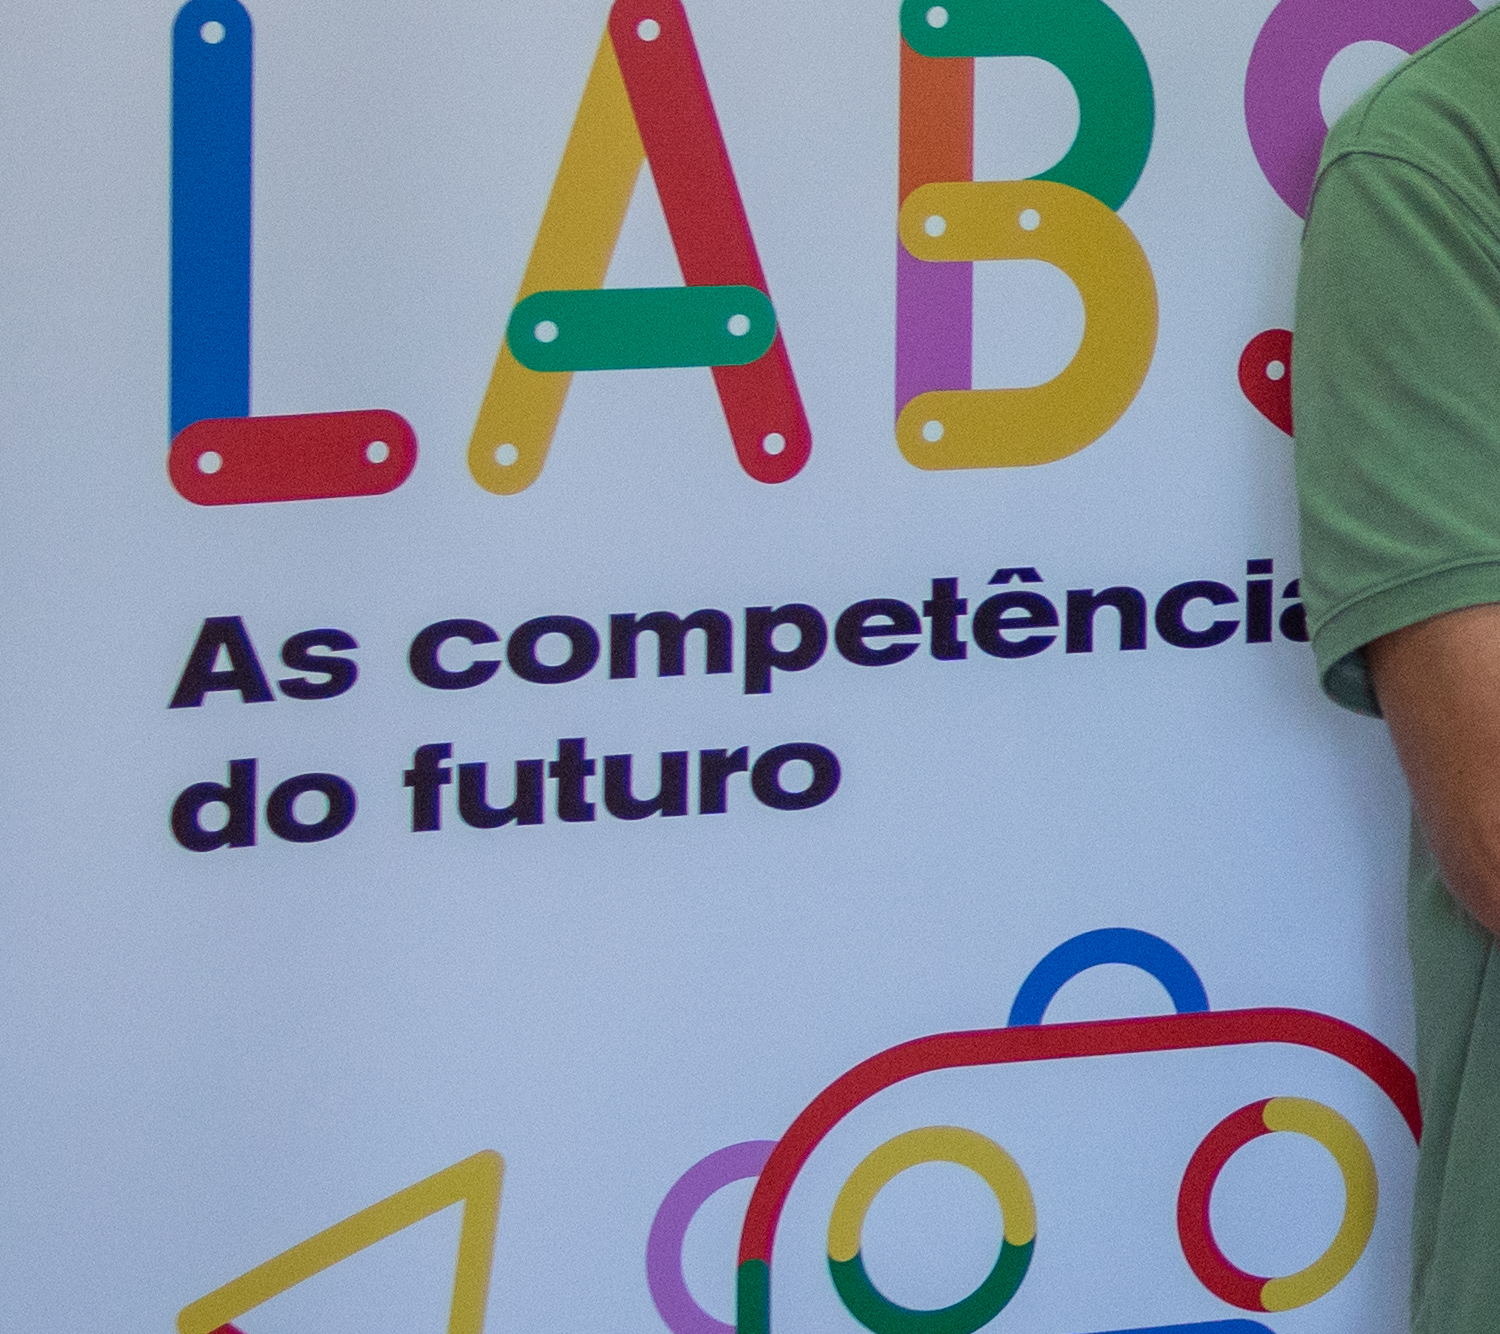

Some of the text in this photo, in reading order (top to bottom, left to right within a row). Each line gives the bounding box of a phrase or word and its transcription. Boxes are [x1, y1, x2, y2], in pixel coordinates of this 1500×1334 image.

[168, 612, 360, 714] As
[168, 733, 844, 856] do futuro
